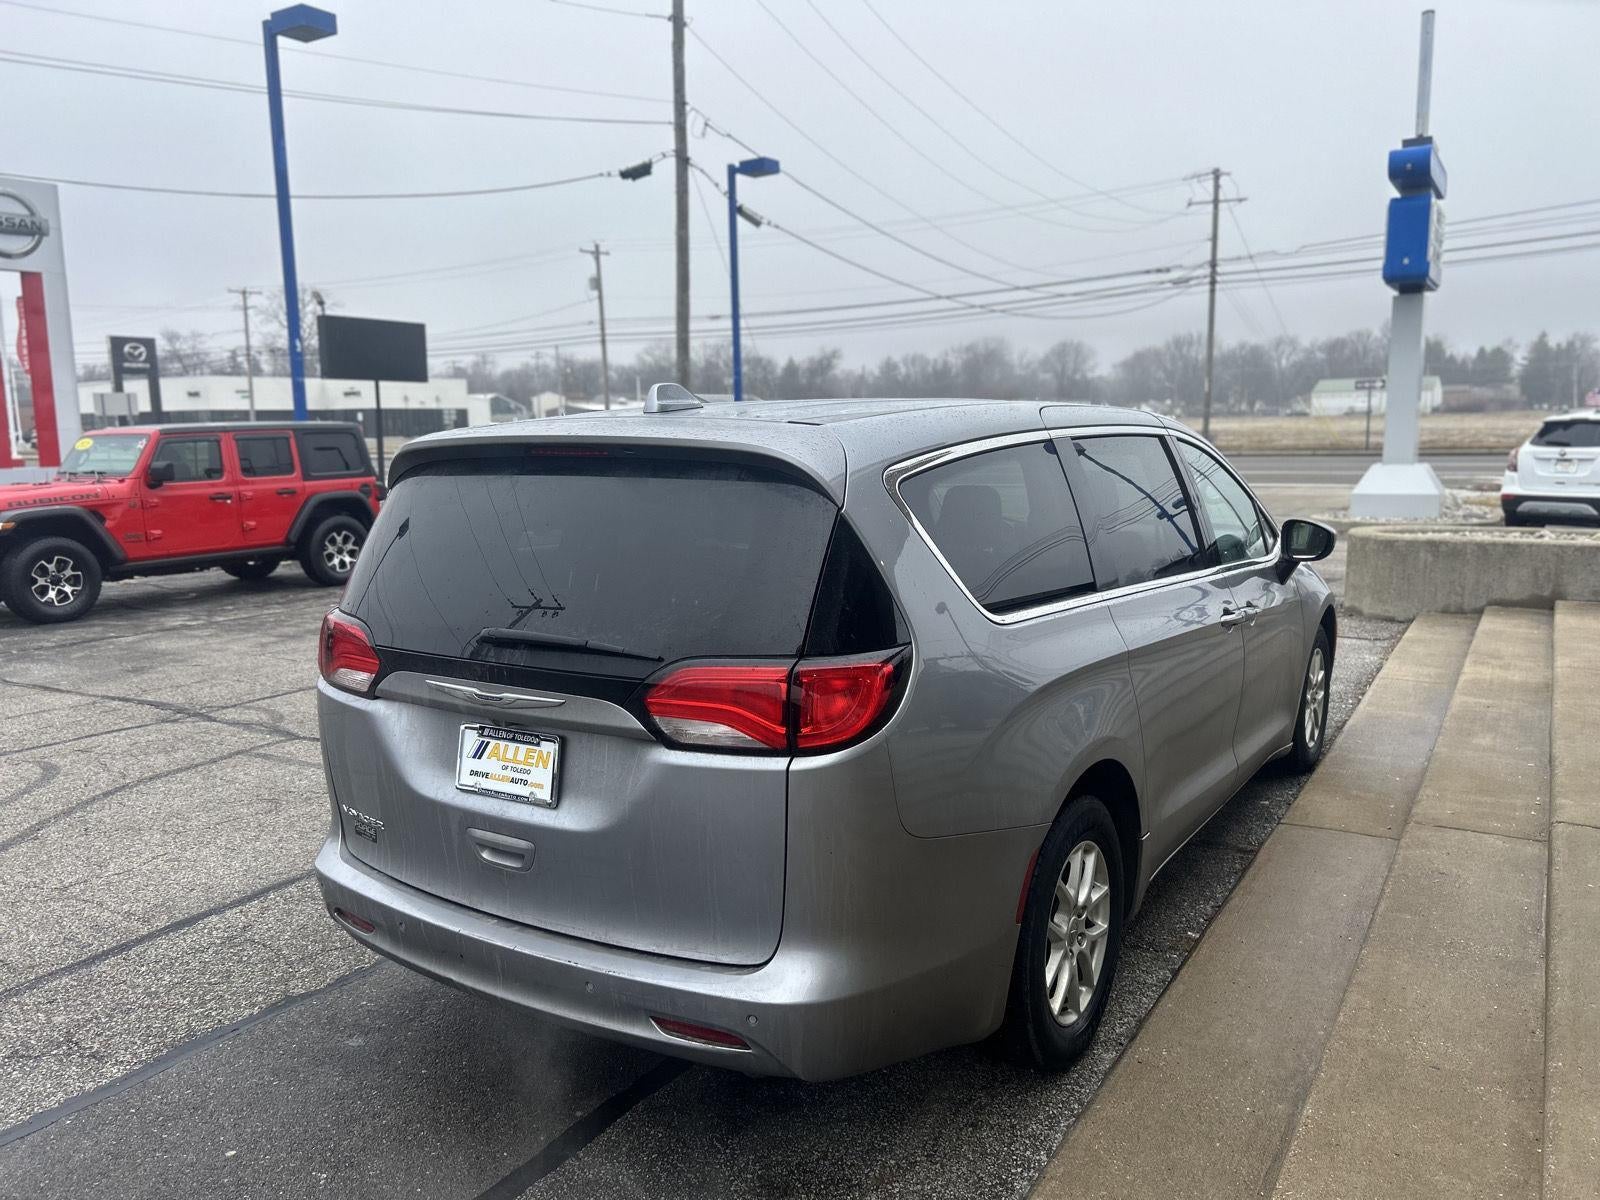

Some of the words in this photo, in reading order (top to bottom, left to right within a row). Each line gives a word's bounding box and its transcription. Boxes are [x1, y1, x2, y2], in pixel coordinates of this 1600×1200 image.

[0, 215, 42, 231] SAN
[7, 493, 99, 508] RUBICON
[488, 728, 507, 738] ALLEN
[507, 731, 513, 739] OF
[514, 733, 534, 743] TOLEDO
[487, 742, 551, 769] ALLEN
[510, 766, 531, 775] TOLEDO
